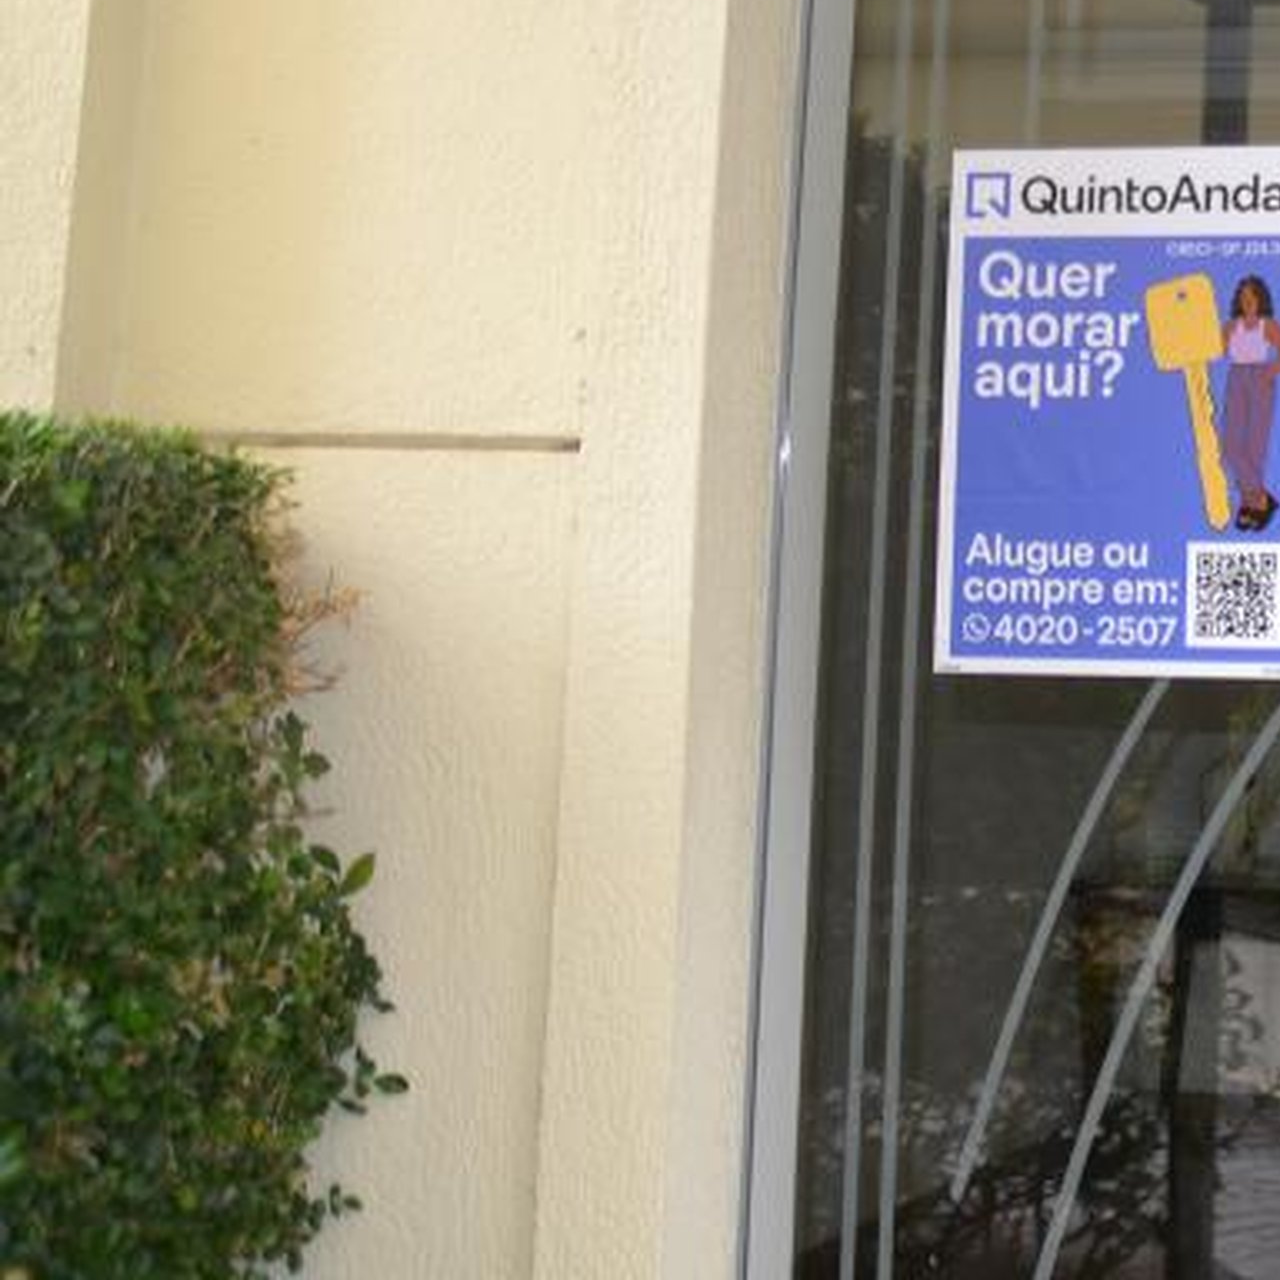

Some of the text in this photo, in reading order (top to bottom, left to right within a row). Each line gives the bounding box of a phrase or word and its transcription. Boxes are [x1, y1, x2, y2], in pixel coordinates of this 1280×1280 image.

[979, 250, 1117, 300] Quer
[977, 311, 1140, 348] morar
[974, 350, 1124, 410] aqui?
[965, 532, 1149, 576] Alugue ou
[963, 576, 1179, 610] compre em:
